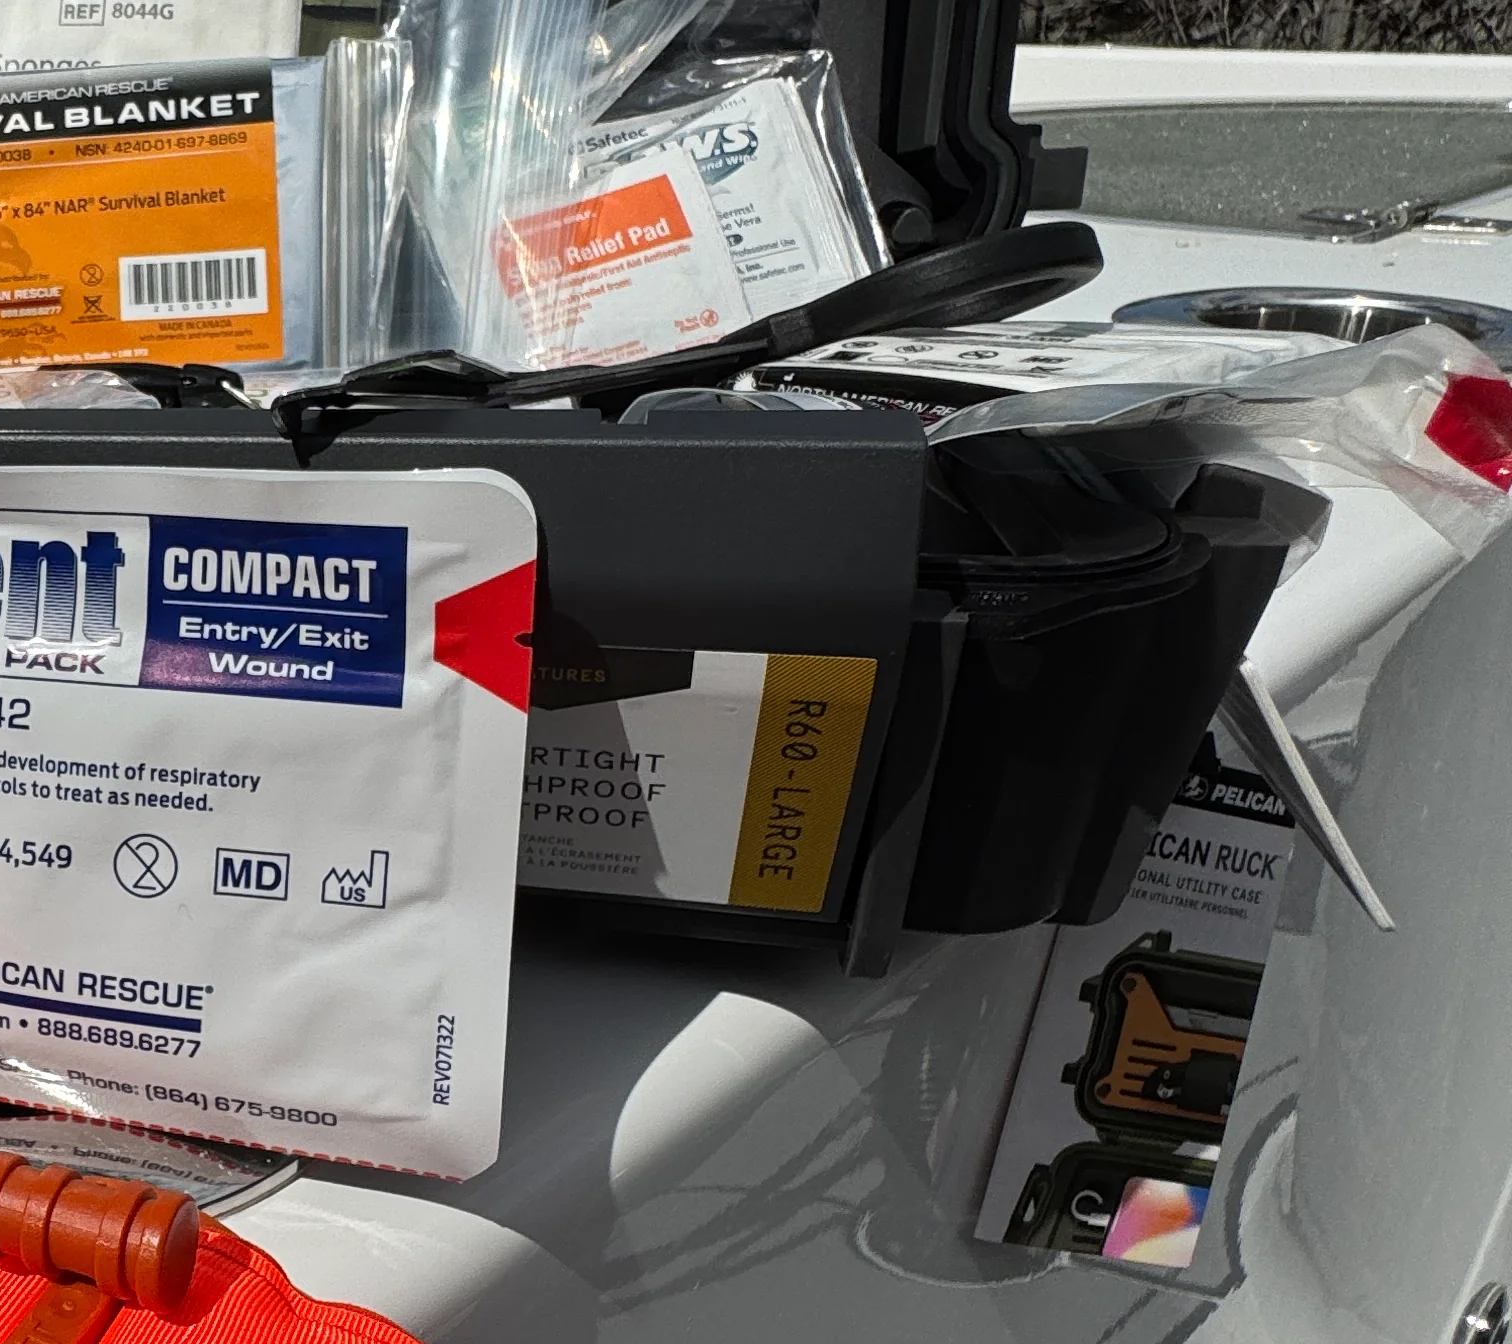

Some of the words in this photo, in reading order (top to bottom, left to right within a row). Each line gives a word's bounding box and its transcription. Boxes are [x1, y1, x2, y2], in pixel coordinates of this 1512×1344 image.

[64, 4, 100, 20] REF
[111, 3, 174, 20] 8044G
[0, 87, 93, 106] AMERICAN
[64, 91, 260, 129] BLANKET
[584, 127, 649, 153] Safetec
[699, 157, 723, 173] and
[11, 207, 21, 218] x
[99, 191, 161, 212] Survival
[165, 187, 226, 207] Blanket
[565, 231, 625, 265] Relief
[627, 217, 671, 246] Pad
[14, 287, 63, 299] RESCUE
[162, 547, 377, 603] COMPACT
[178, 616, 369, 651] Entry/Exit
[5, 646, 106, 675] PACK
[208, 652, 335, 682] Wound
[533, 667, 606, 683] TURES
[530, 746, 665, 773] RTIGHT
[124, 763, 146, 780] of
[150, 766, 261, 793] respiratory
[523, 774, 666, 801] HPROOF
[31, 779, 51, 799] to
[55, 784, 103, 804] treat
[107, 790, 129, 806] as
[135, 791, 214, 812] needed.
[1210, 784, 1286, 816] PELICAN
[1147, 831, 1212, 867] ICAN
[1214, 843, 1281, 881] RUCK
[221, 857, 283, 891] MD
[1136, 869, 1172, 888] ONAL
[1176, 876, 1228, 898] UTILITY
[1231, 887, 1263, 905] CASE
[339, 886, 366, 902] US
[37, 1018, 202, 1059] 888.689.6277
[432, 1014, 456, 1106] REV071322
[68, 1069, 140, 1096] Phone:
[144, 1083, 209, 1111] (864)
[214, 1096, 338, 1128] 675-9800
